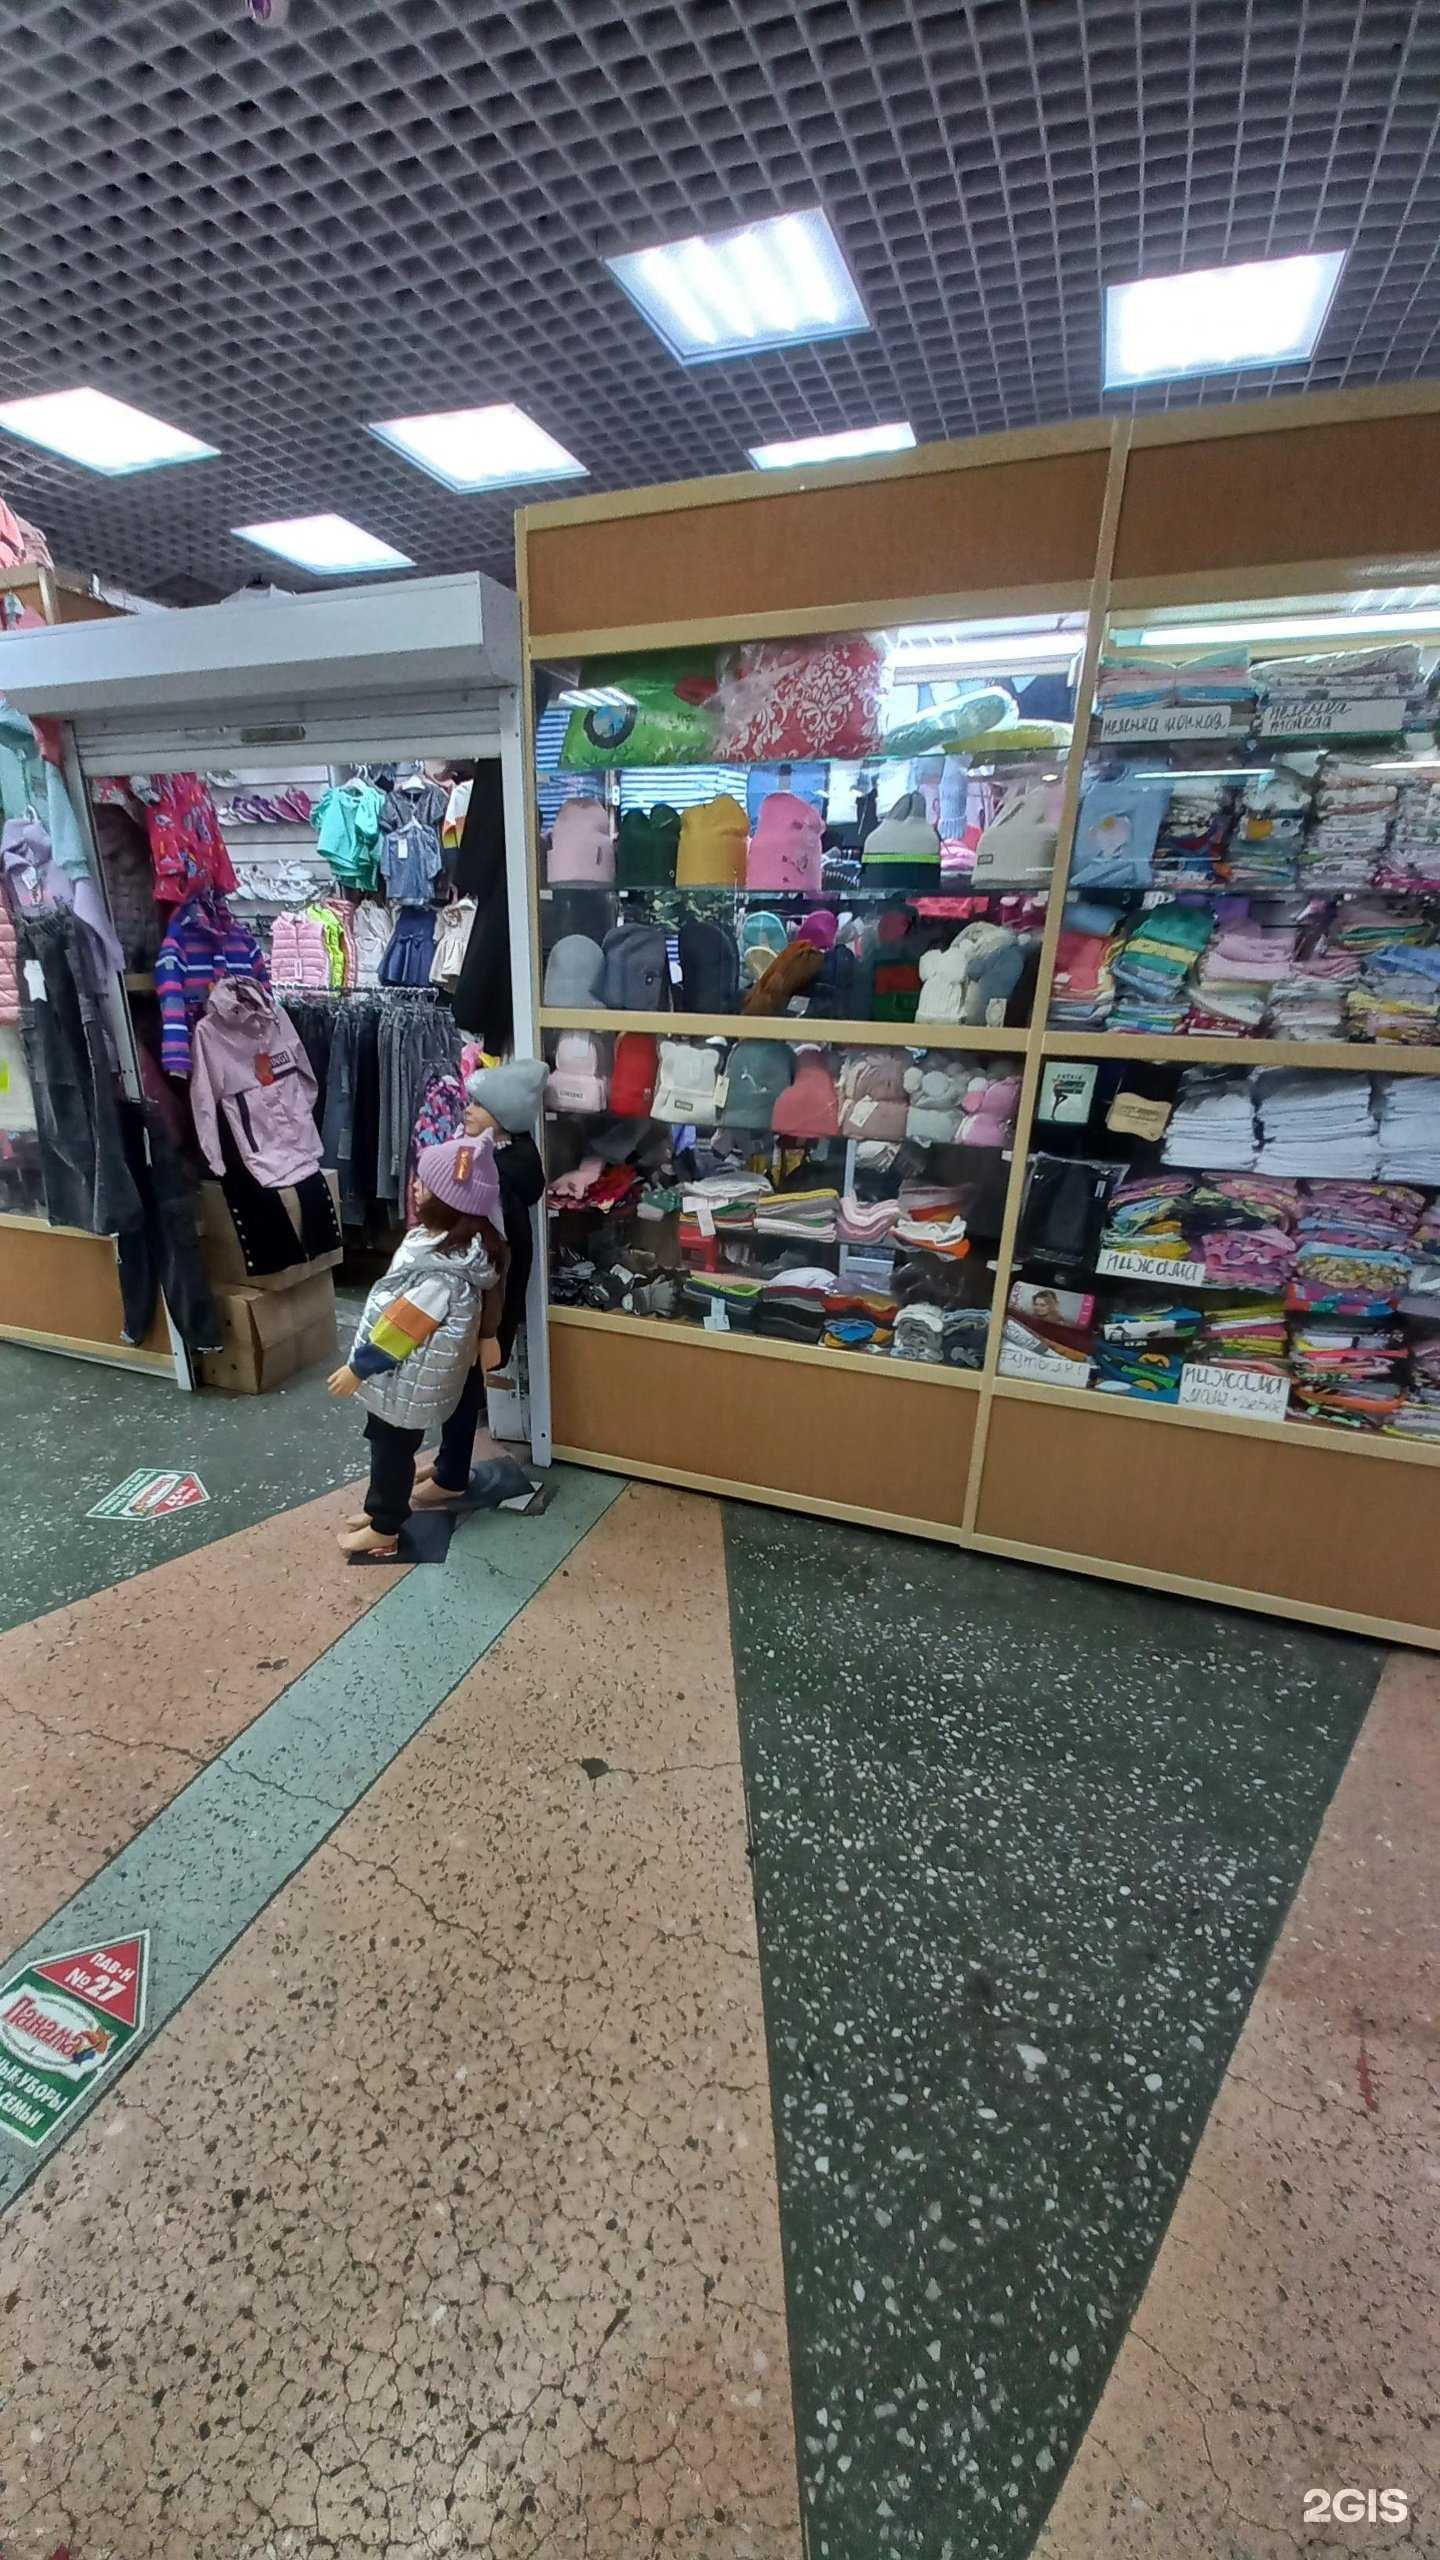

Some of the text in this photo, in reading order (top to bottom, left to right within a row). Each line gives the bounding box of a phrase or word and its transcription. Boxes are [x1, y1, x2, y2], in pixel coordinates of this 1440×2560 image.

[2, 1996, 82, 2057] Панама
[0, 2091, 45, 2128] СЕМЬИ
[16, 2072, 69, 2112] УБОРЫ
